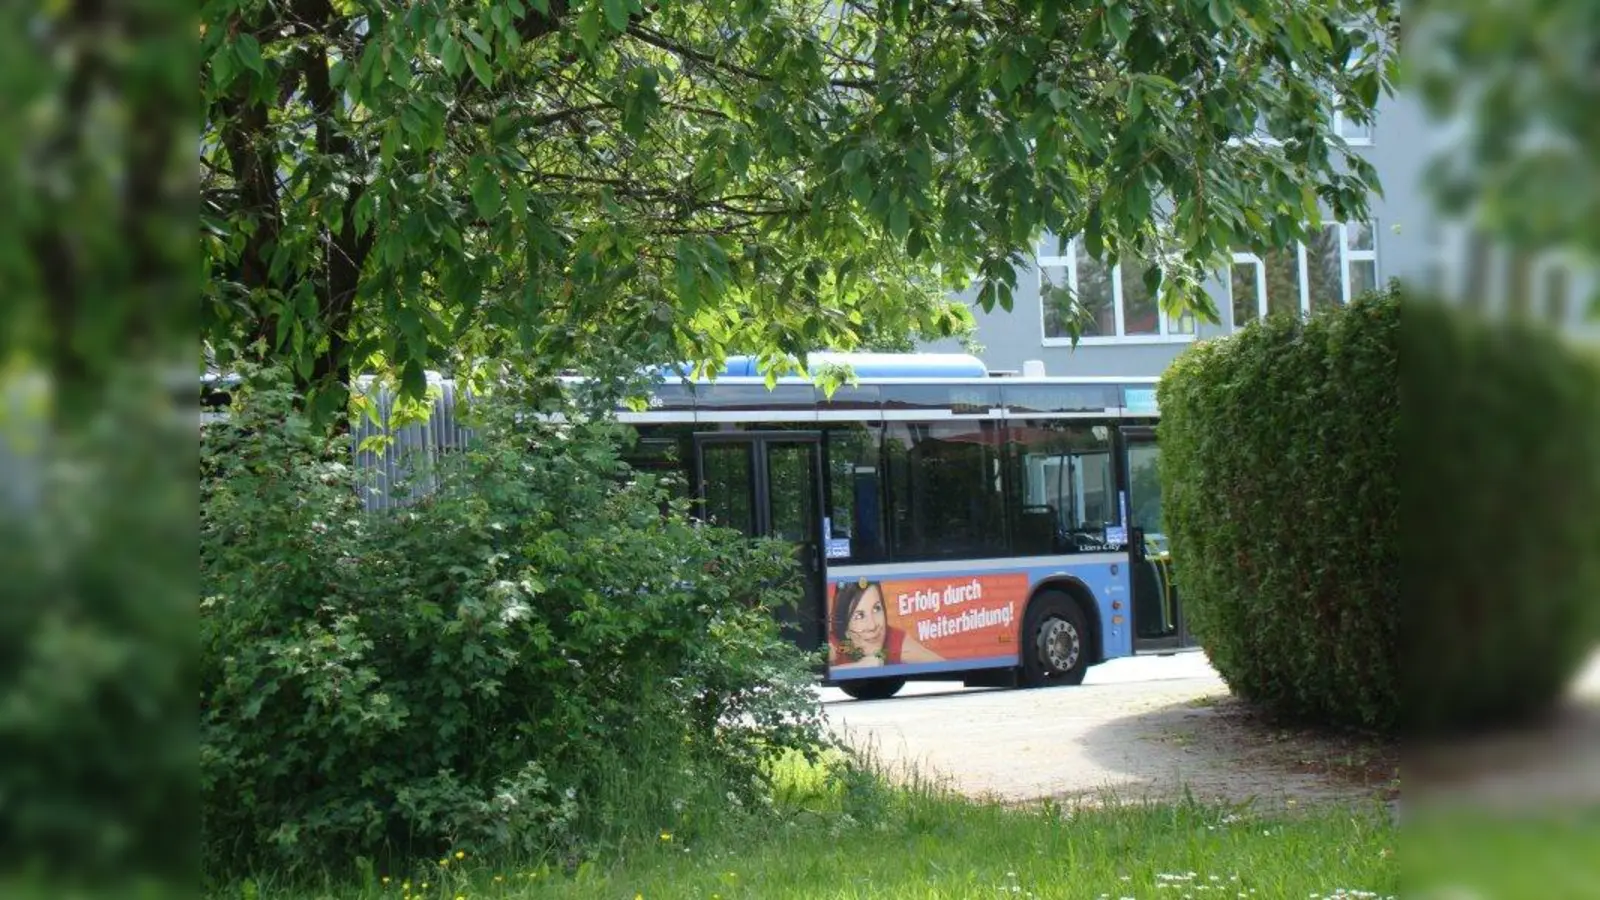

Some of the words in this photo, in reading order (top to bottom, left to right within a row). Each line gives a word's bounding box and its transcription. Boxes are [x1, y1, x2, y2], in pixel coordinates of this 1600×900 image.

[899, 588, 940, 615] Erfolg
[944, 579, 981, 605] durch
[917, 601, 1014, 641] Weiterbildung!
